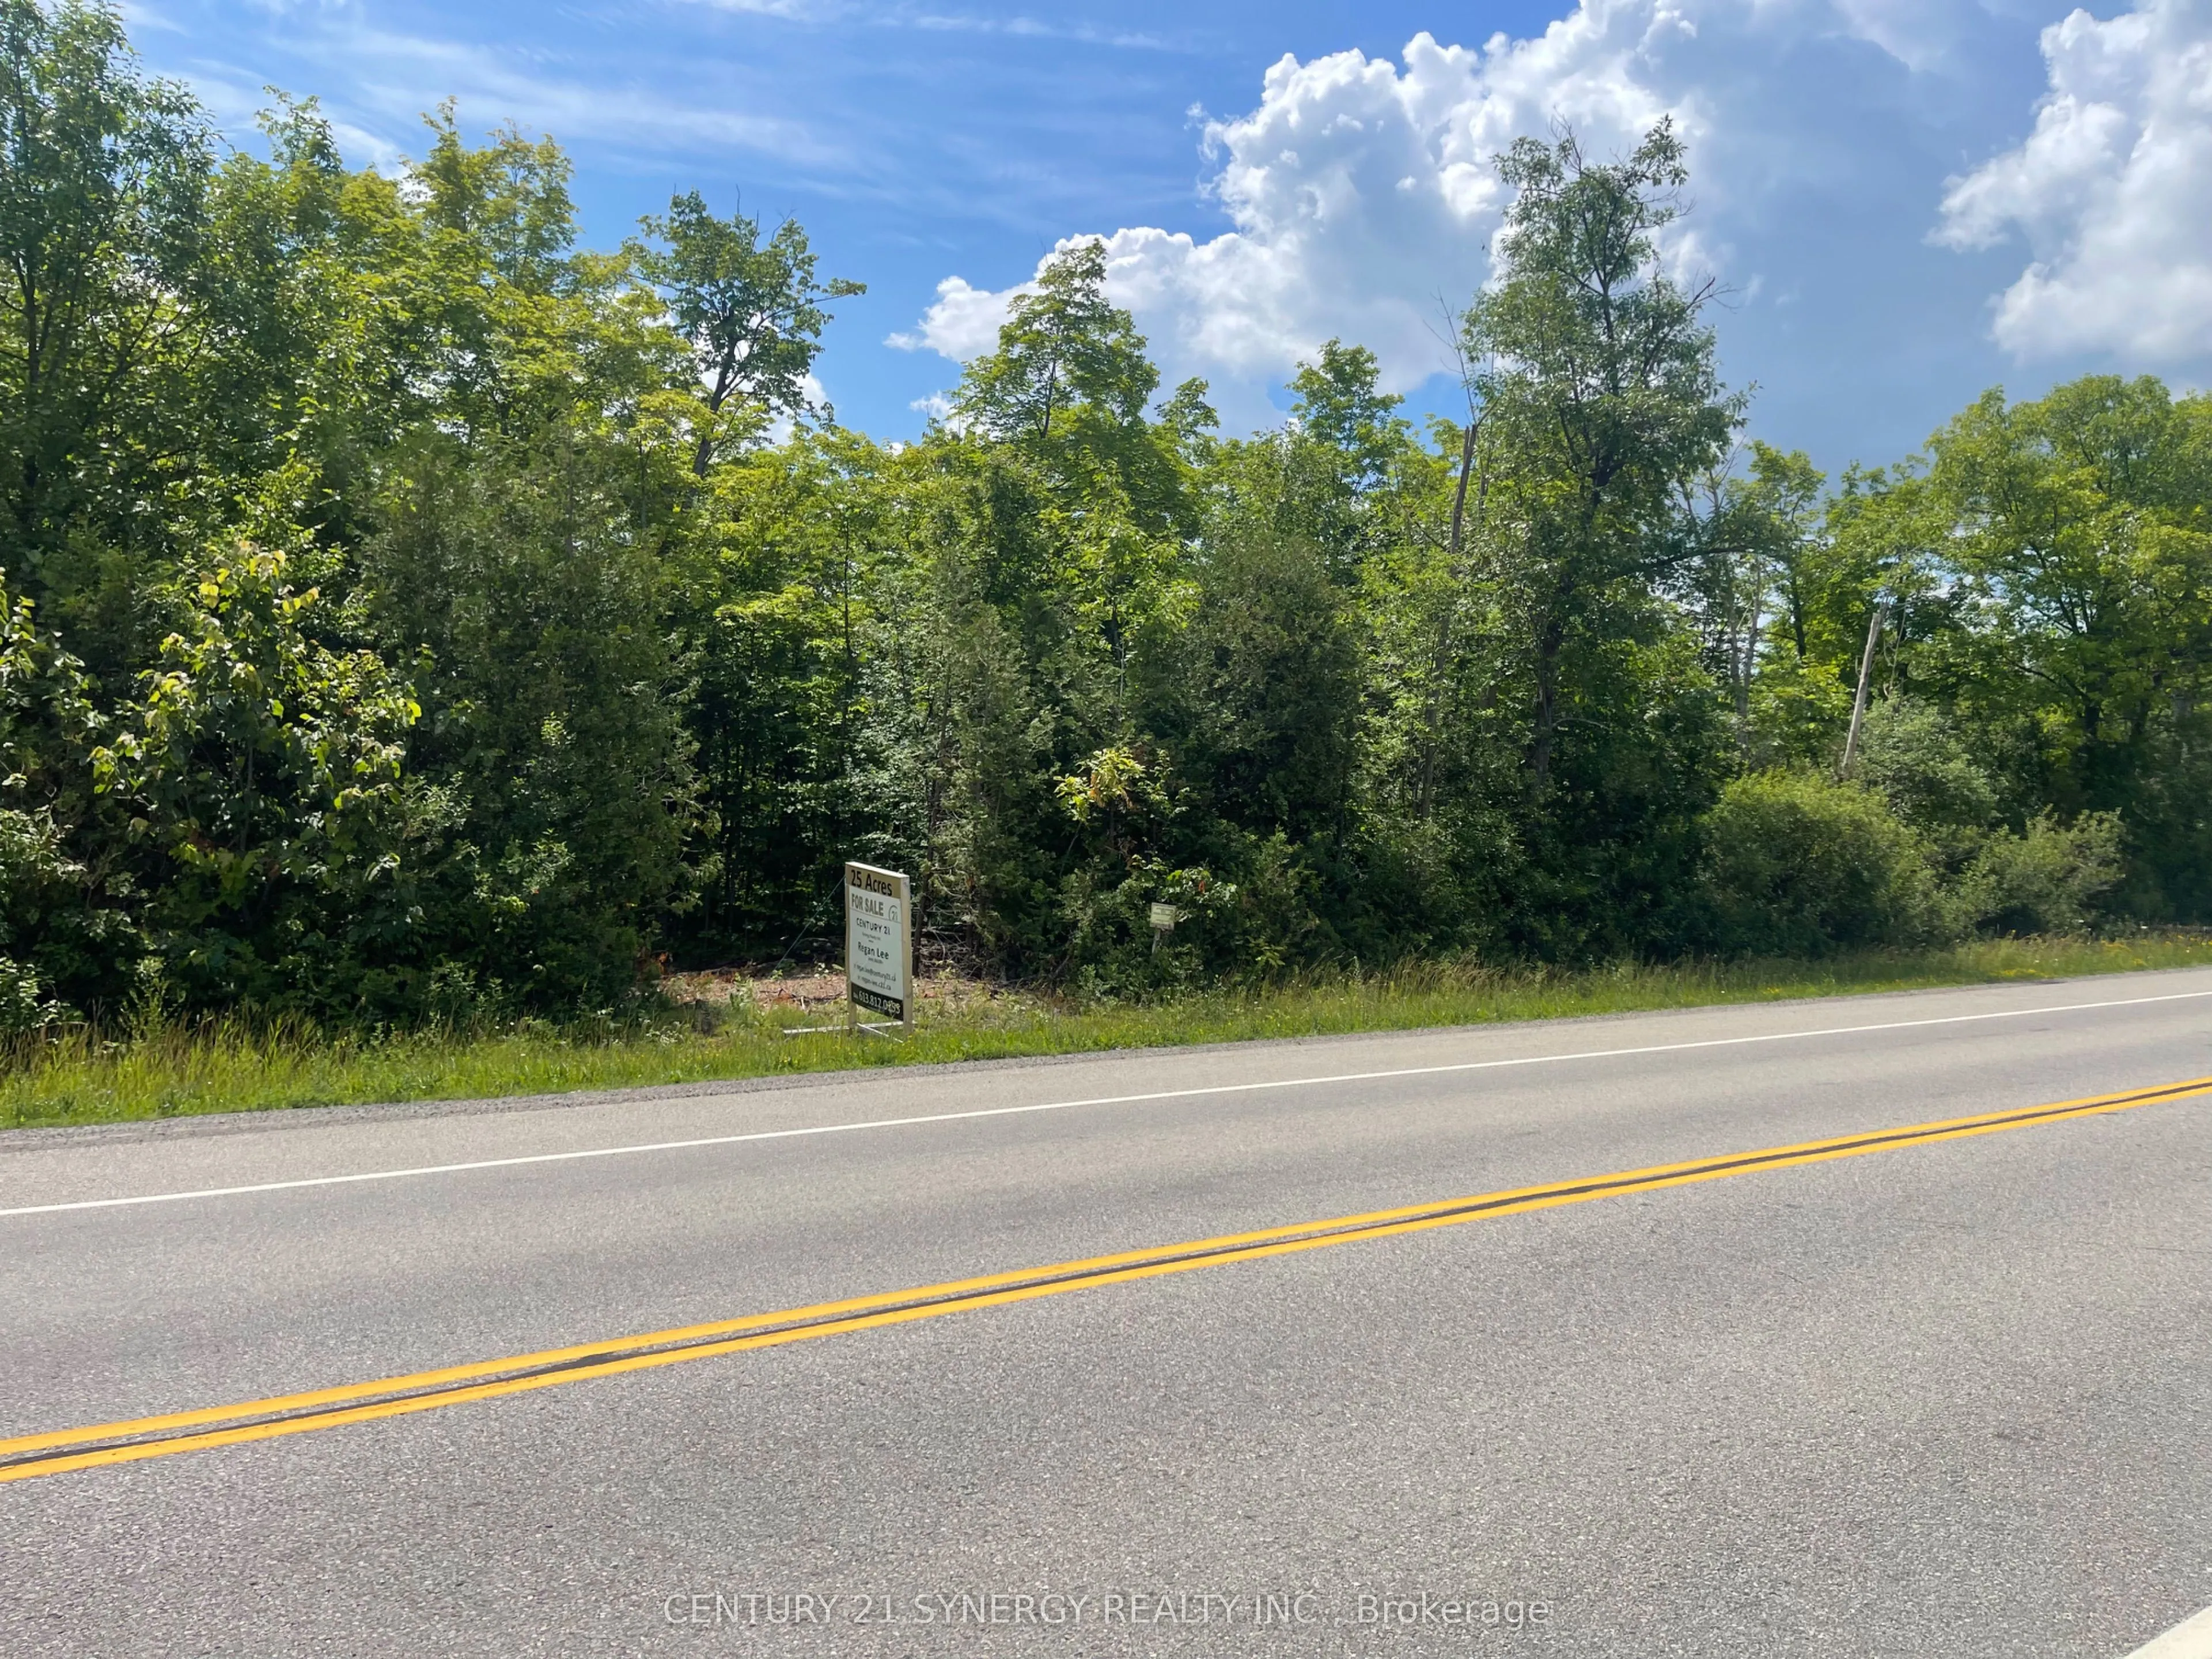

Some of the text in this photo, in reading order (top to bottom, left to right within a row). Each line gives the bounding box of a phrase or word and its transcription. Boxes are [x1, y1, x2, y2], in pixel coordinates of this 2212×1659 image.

[851, 870, 892, 896] 25 Acres
[851, 893, 884, 916] FOR SALE
[857, 918, 891, 935] CENTURY 21
[858, 941, 889, 960] Regan Lee
